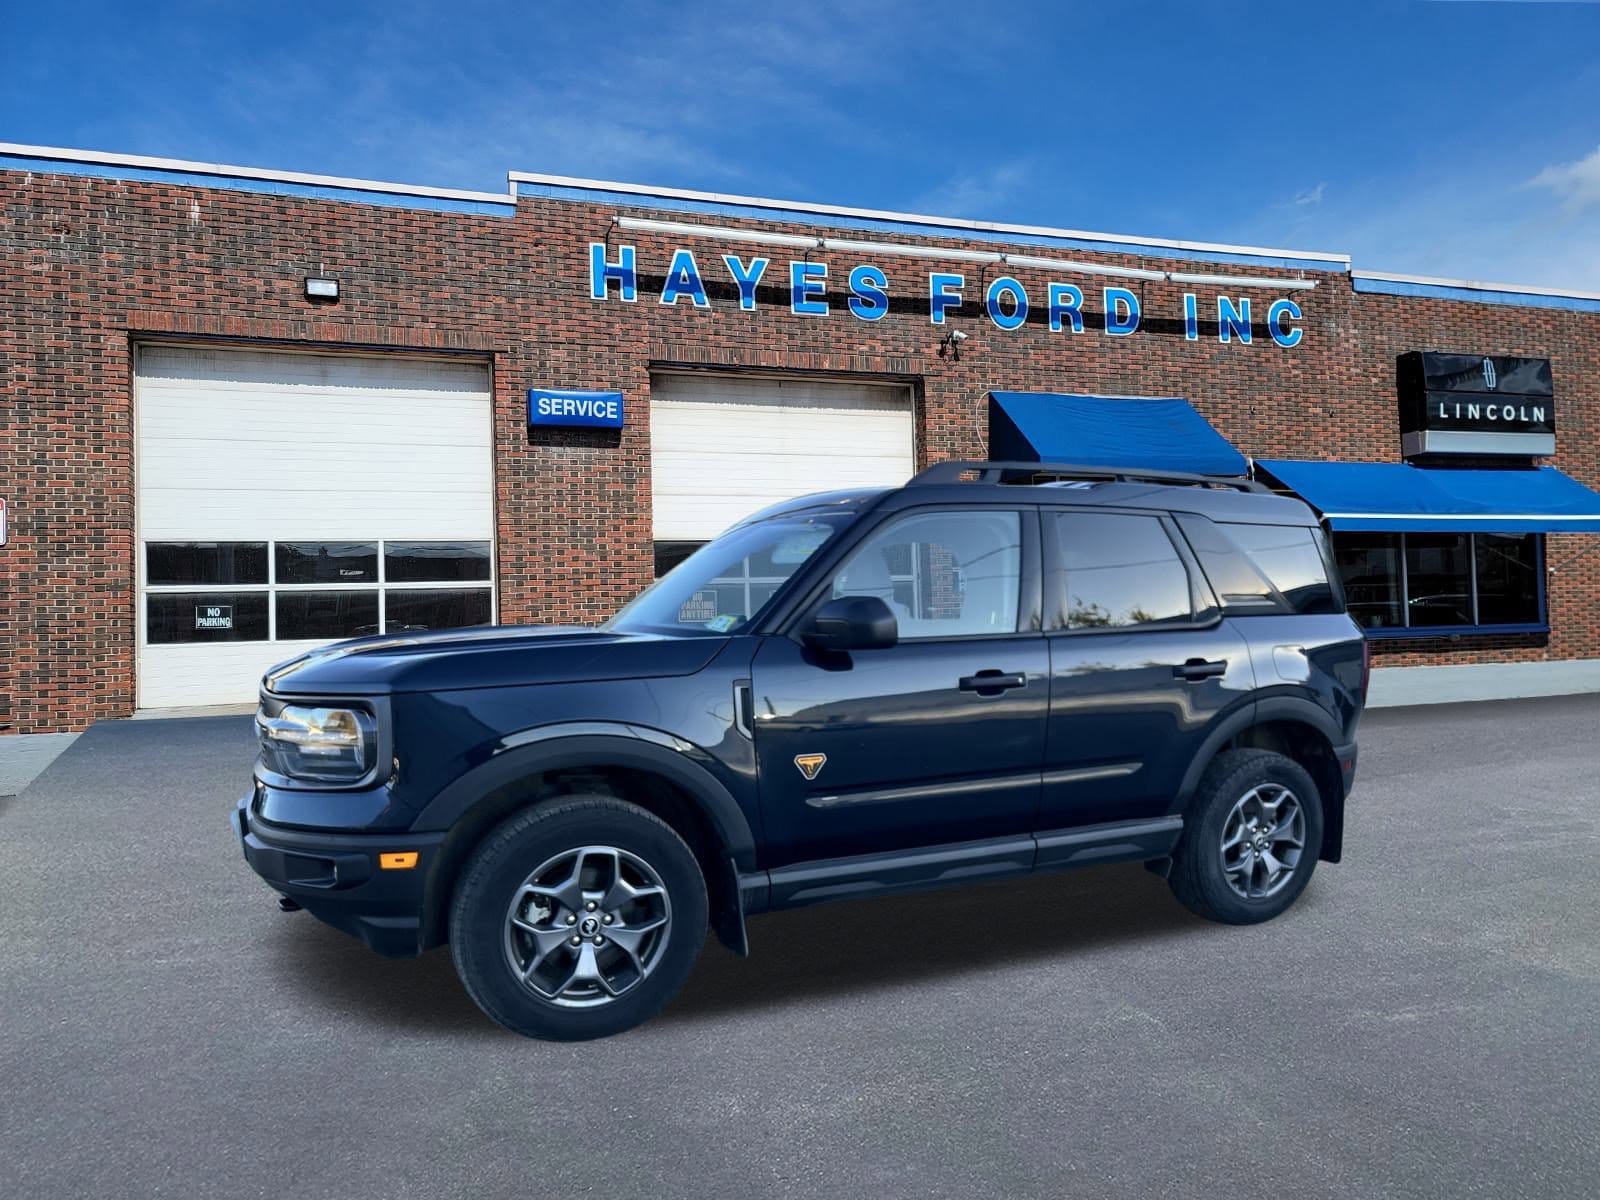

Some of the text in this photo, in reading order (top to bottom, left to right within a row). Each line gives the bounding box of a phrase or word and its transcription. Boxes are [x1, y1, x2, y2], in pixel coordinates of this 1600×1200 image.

[589, 242, 1304, 349] HAYES FORD INC
[538, 397, 618, 419] SERVICE
[1439, 402, 1546, 423] LINCOLN
[197, 617, 231, 627] PARKING
[207, 607, 221, 617] NO
